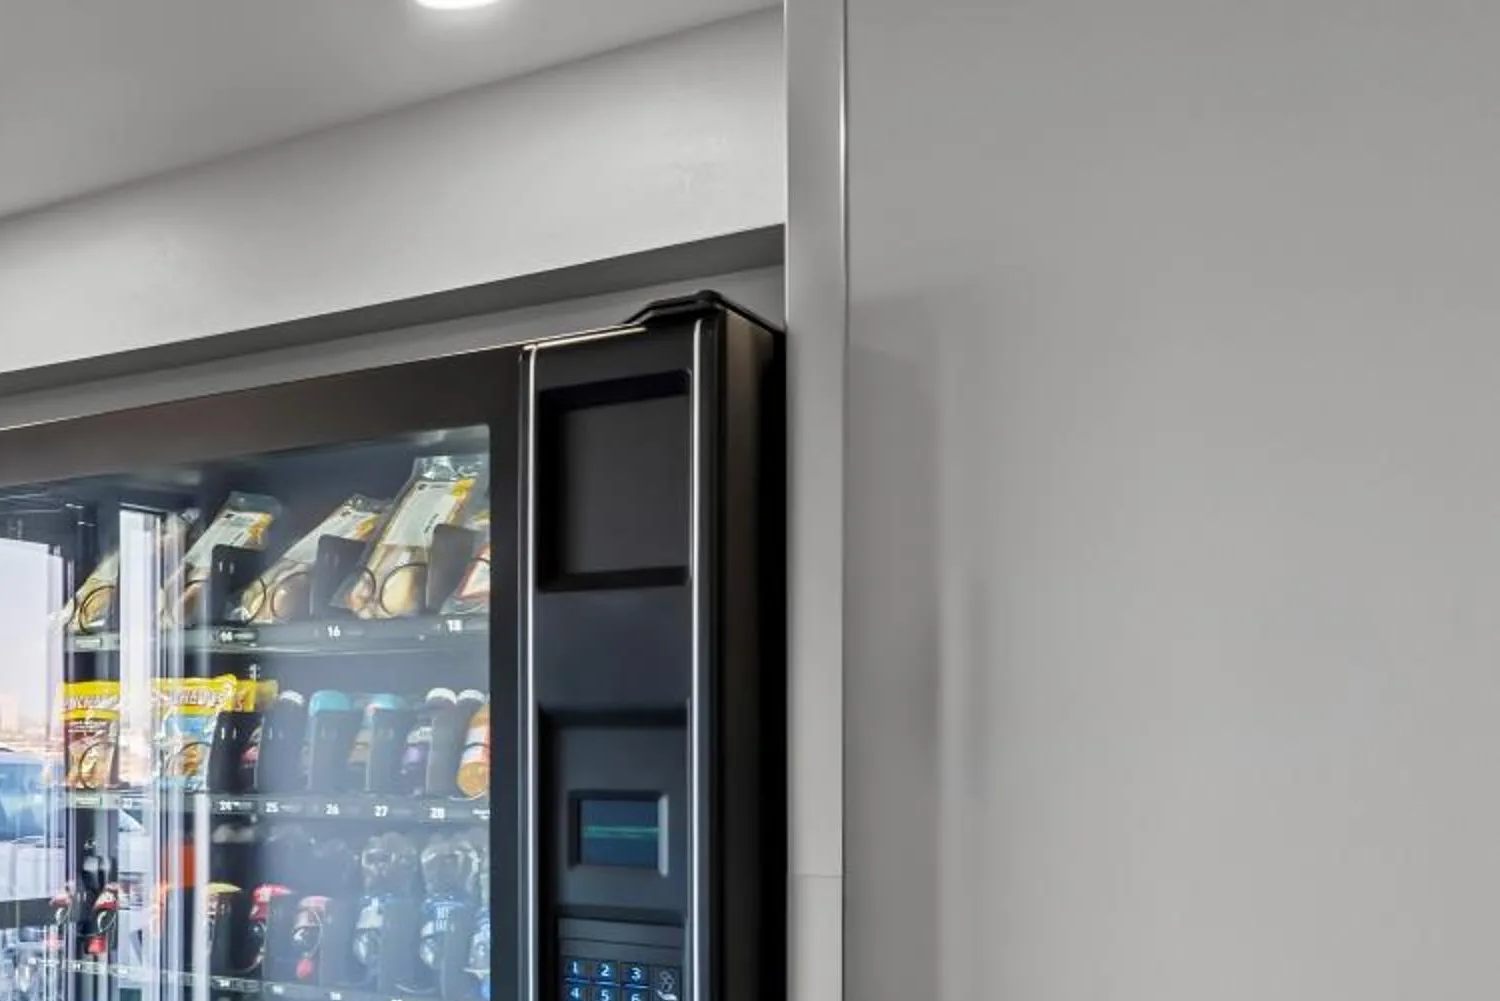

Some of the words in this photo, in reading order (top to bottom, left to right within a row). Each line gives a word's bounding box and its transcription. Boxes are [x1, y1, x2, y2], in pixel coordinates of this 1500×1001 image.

[327, 625, 341, 637] 16
[265, 801, 279, 813] 25
[325, 803, 339, 815] 26
[375, 805, 389, 817] 27
[601, 963, 611, 977] 2
[631, 967, 641, 981] 3
[570, 987, 580, 999] 4
